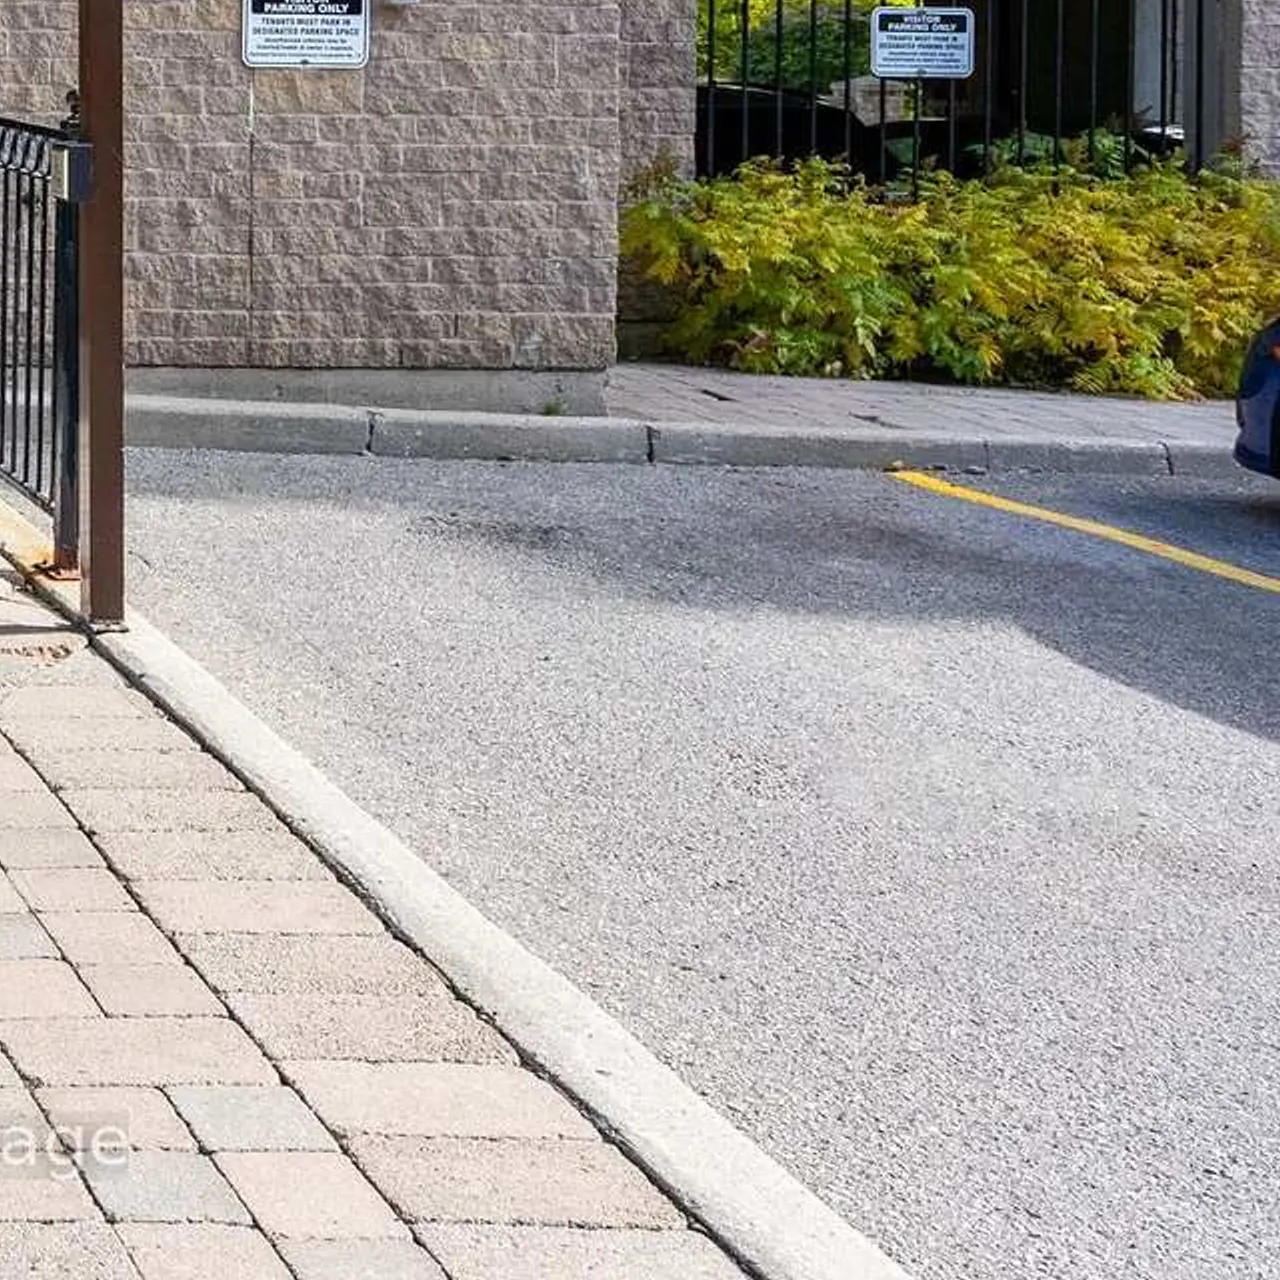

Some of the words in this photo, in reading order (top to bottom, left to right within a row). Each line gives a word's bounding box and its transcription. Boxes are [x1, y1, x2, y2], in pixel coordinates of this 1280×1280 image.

[263, 2, 316, 14] PARKING
[318, 3, 350, 14] ONLY
[888, 23, 929, 31] PARKING
[931, 23, 957, 32] ONLY
